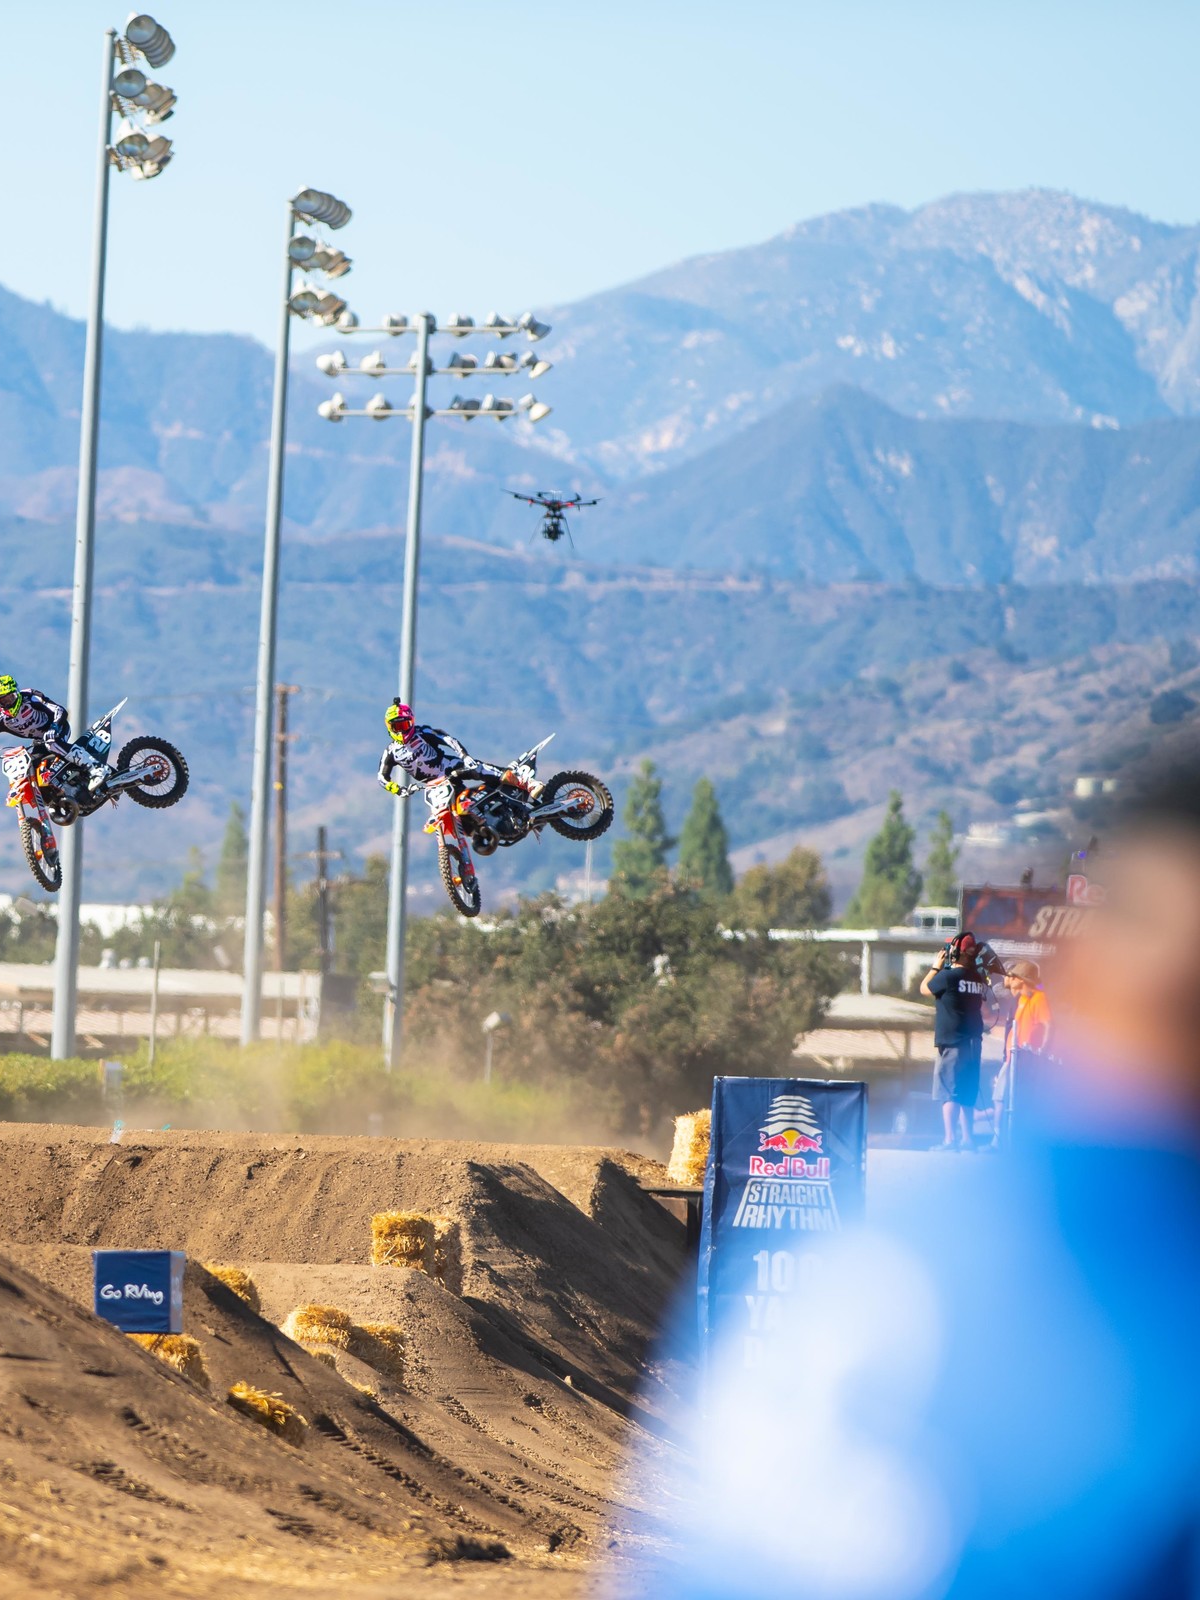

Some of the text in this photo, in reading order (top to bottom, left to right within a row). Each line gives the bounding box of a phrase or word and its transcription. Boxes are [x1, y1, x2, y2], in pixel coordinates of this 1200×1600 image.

[88, 729, 112, 753] 28
[4, 757, 27, 775] 28
[749, 1156, 830, 1179] Red Bull
[748, 1183, 828, 1206] STRAIGHT
[742, 1204, 836, 1231] RHYTHM
[100, 1283, 164, 1306] Go RVing
